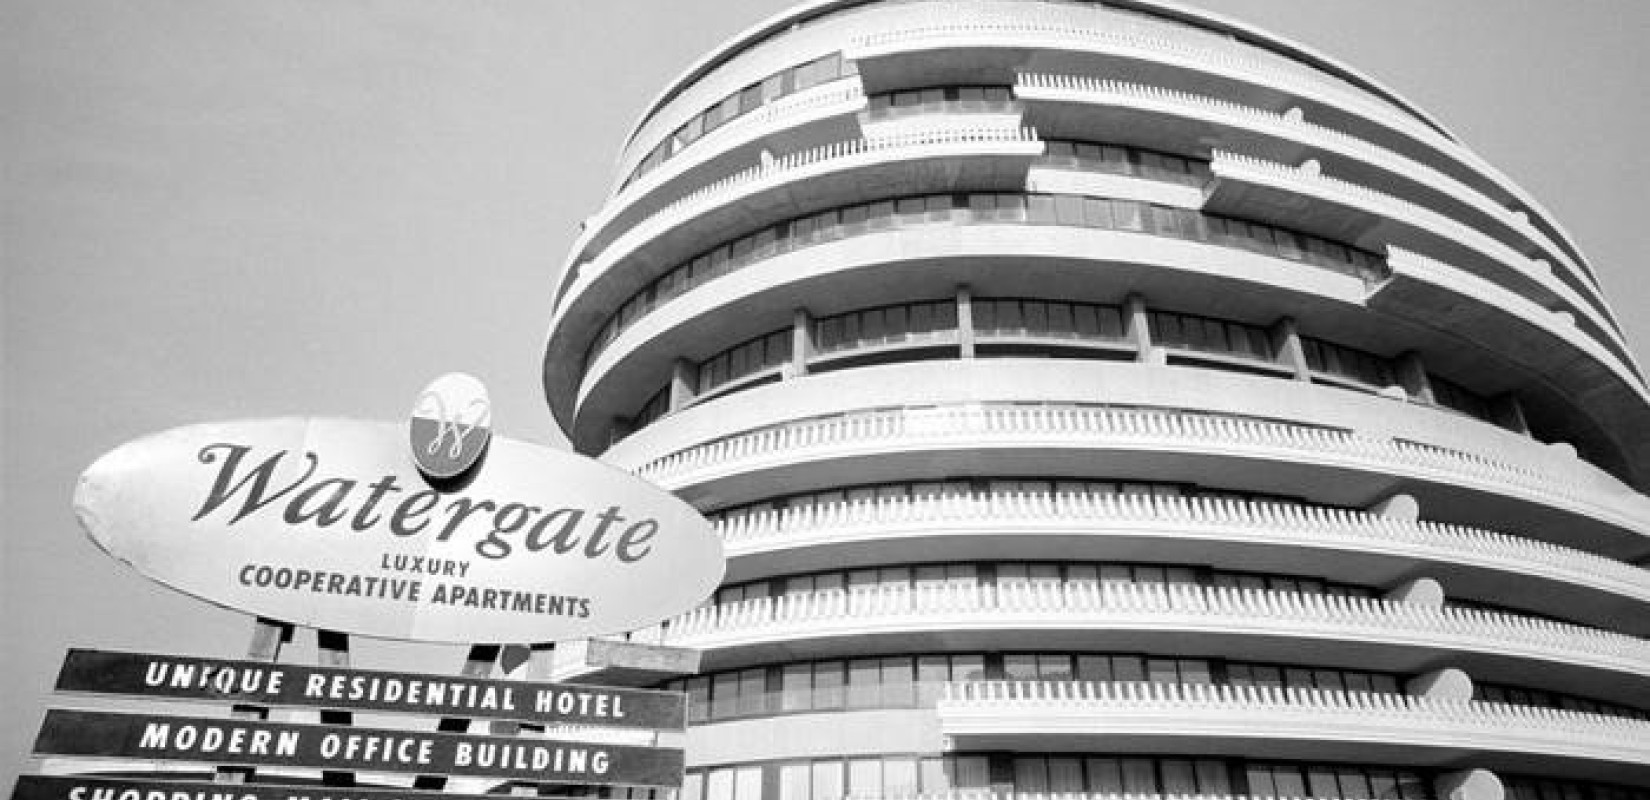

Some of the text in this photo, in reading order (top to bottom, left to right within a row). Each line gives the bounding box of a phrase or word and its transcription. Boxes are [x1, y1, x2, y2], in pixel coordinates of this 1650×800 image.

[192, 442, 659, 563] Watergate
[239, 565, 590, 618] COOPERATIVE APARTMENTS
[381, 553, 470, 578] LUXURY
[145, 662, 625, 718] UNIQUE RESIDENTIAL HOTEL
[139, 723, 609, 774] MODERN OFFICE BUILDING
